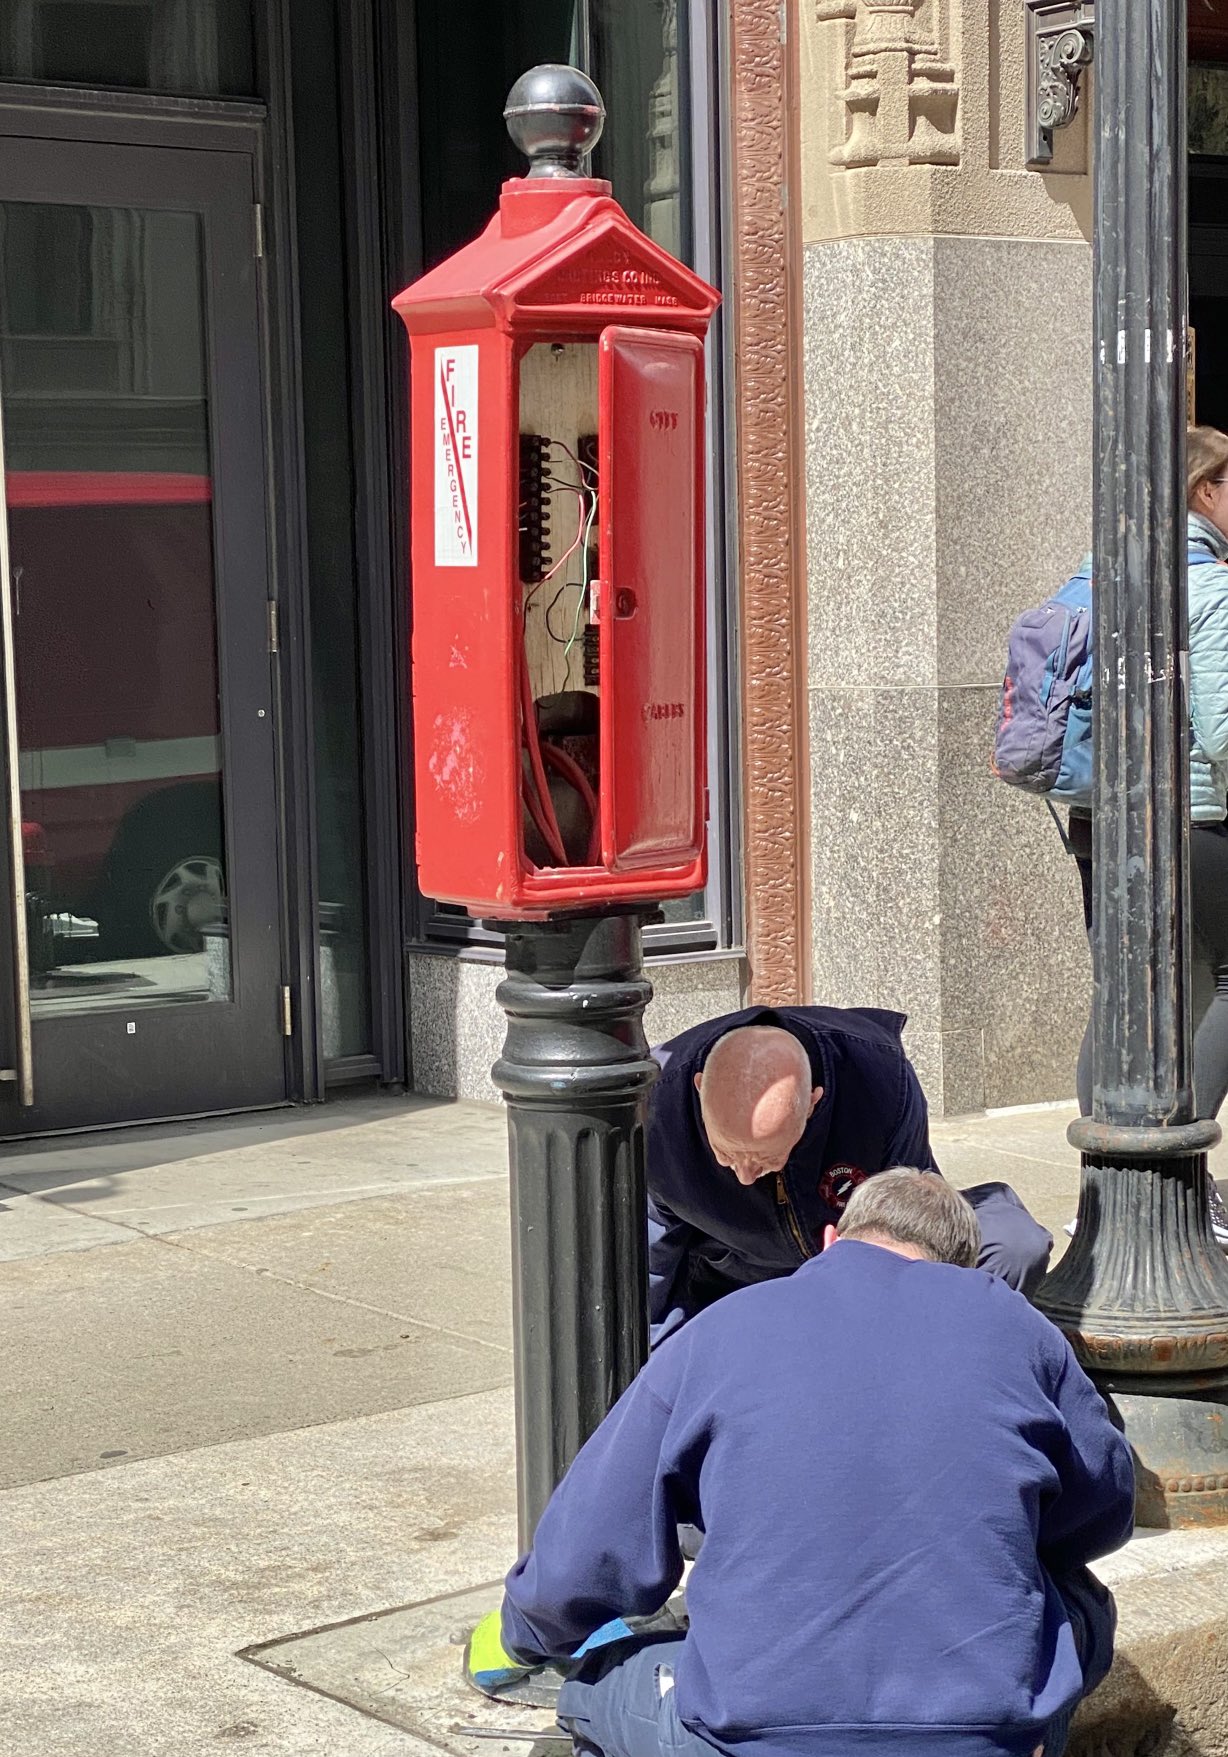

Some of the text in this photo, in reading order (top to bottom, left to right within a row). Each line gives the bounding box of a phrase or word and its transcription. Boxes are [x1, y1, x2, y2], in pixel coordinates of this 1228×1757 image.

[622, 270, 638, 283] CO
[580, 293, 646, 304] BRIDGEWATER
[446, 359, 472, 459] FIRE
[440, 417, 467, 554] EMERGENCY
[829, 1167, 852, 1177] BOSTON
